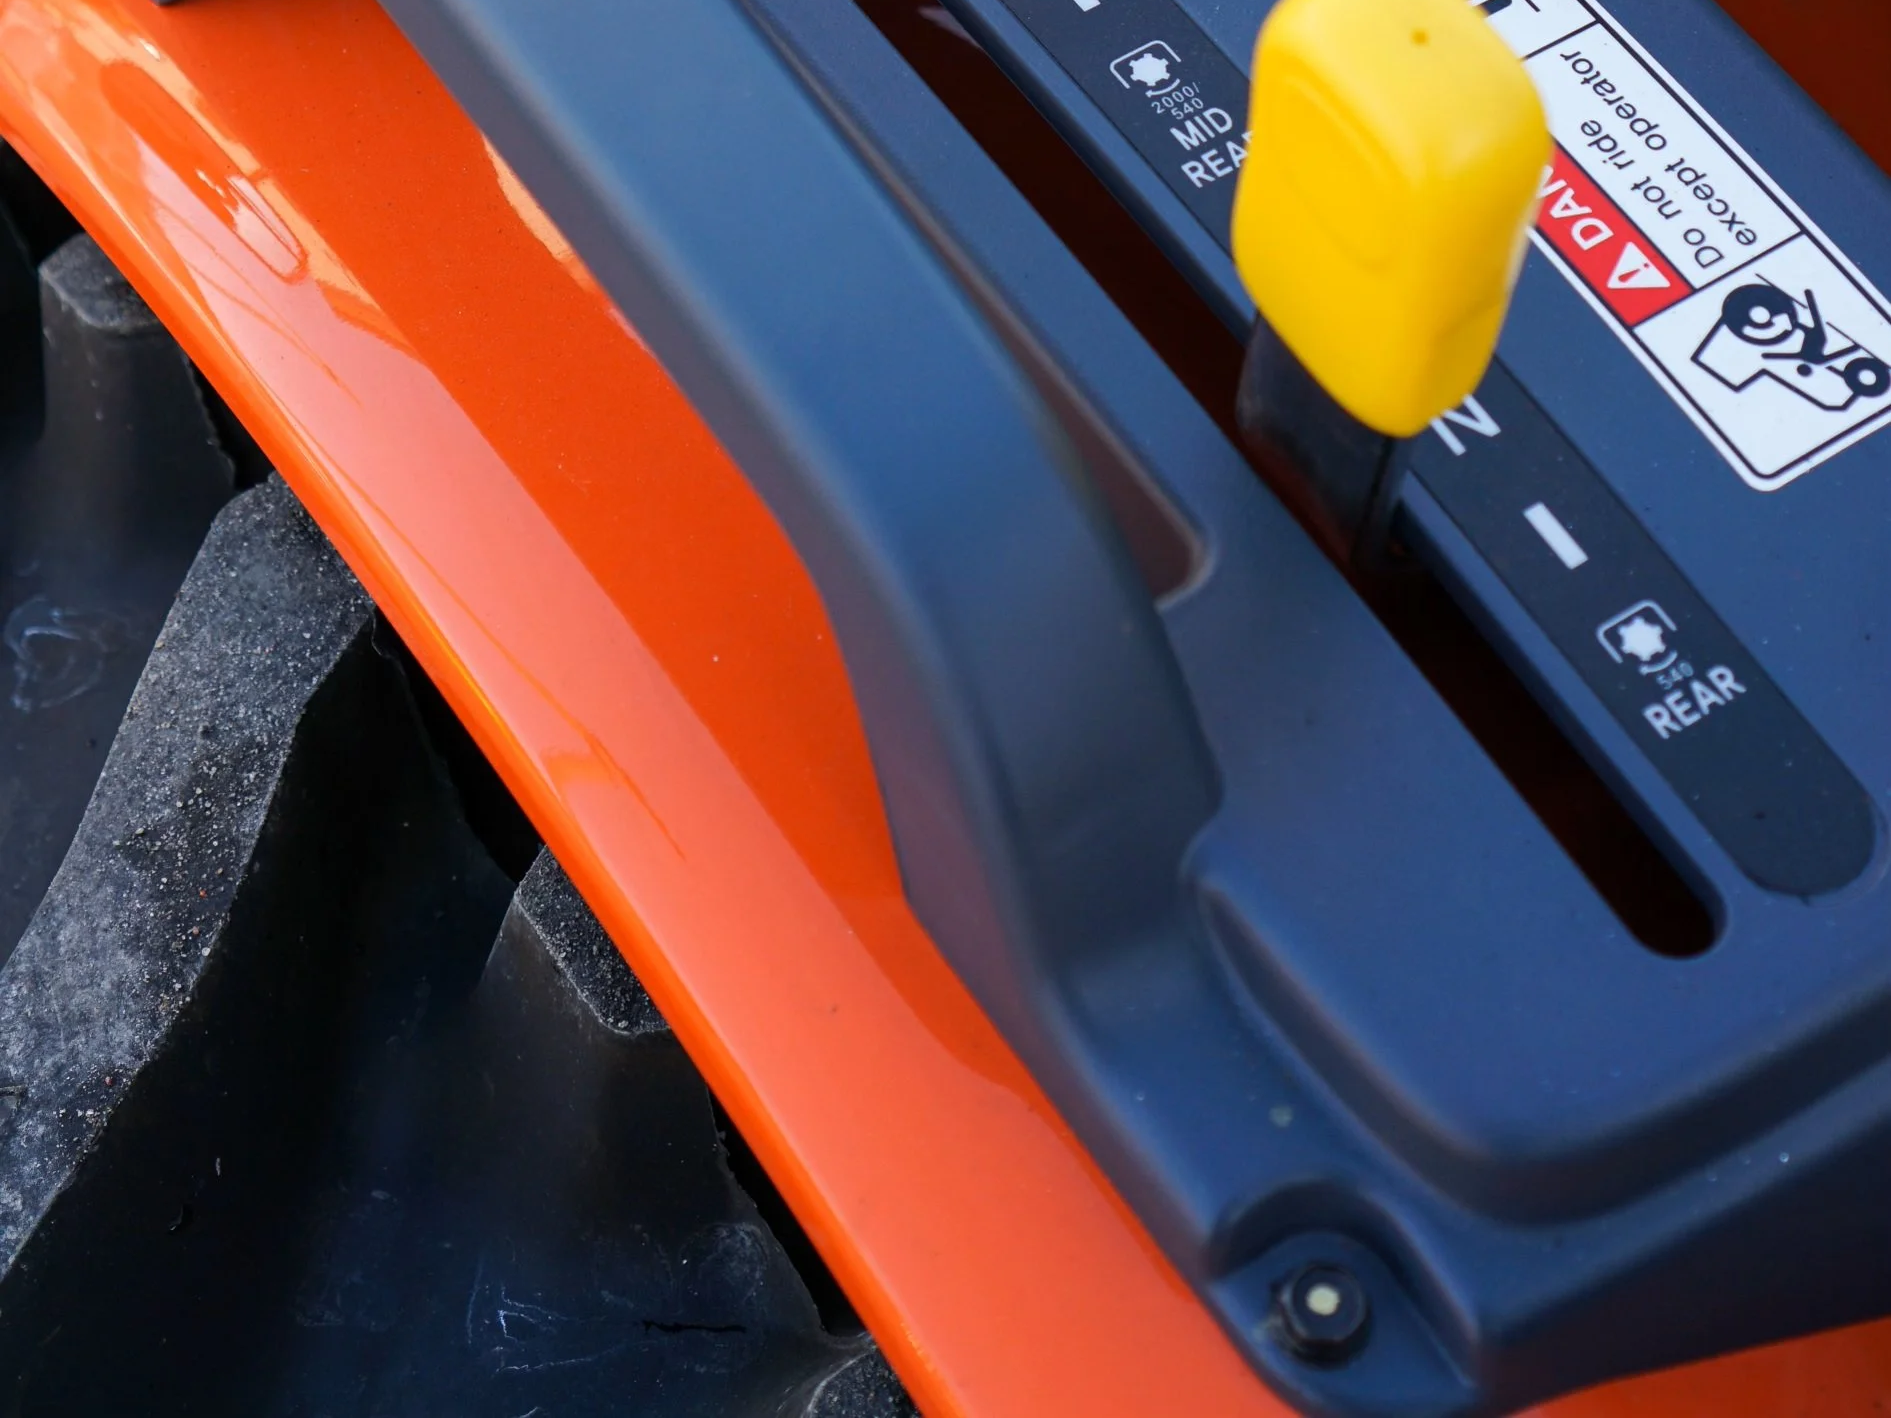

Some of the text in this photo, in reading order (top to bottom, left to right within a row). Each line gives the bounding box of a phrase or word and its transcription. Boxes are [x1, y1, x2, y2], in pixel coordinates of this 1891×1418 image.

[1170, 107, 1233, 151] MID
[1171, 97, 1204, 120] 540
[1560, 51, 1757, 246] except operator
[1580, 120, 1725, 269] Do not ride
[1642, 666, 1747, 740] REAR
